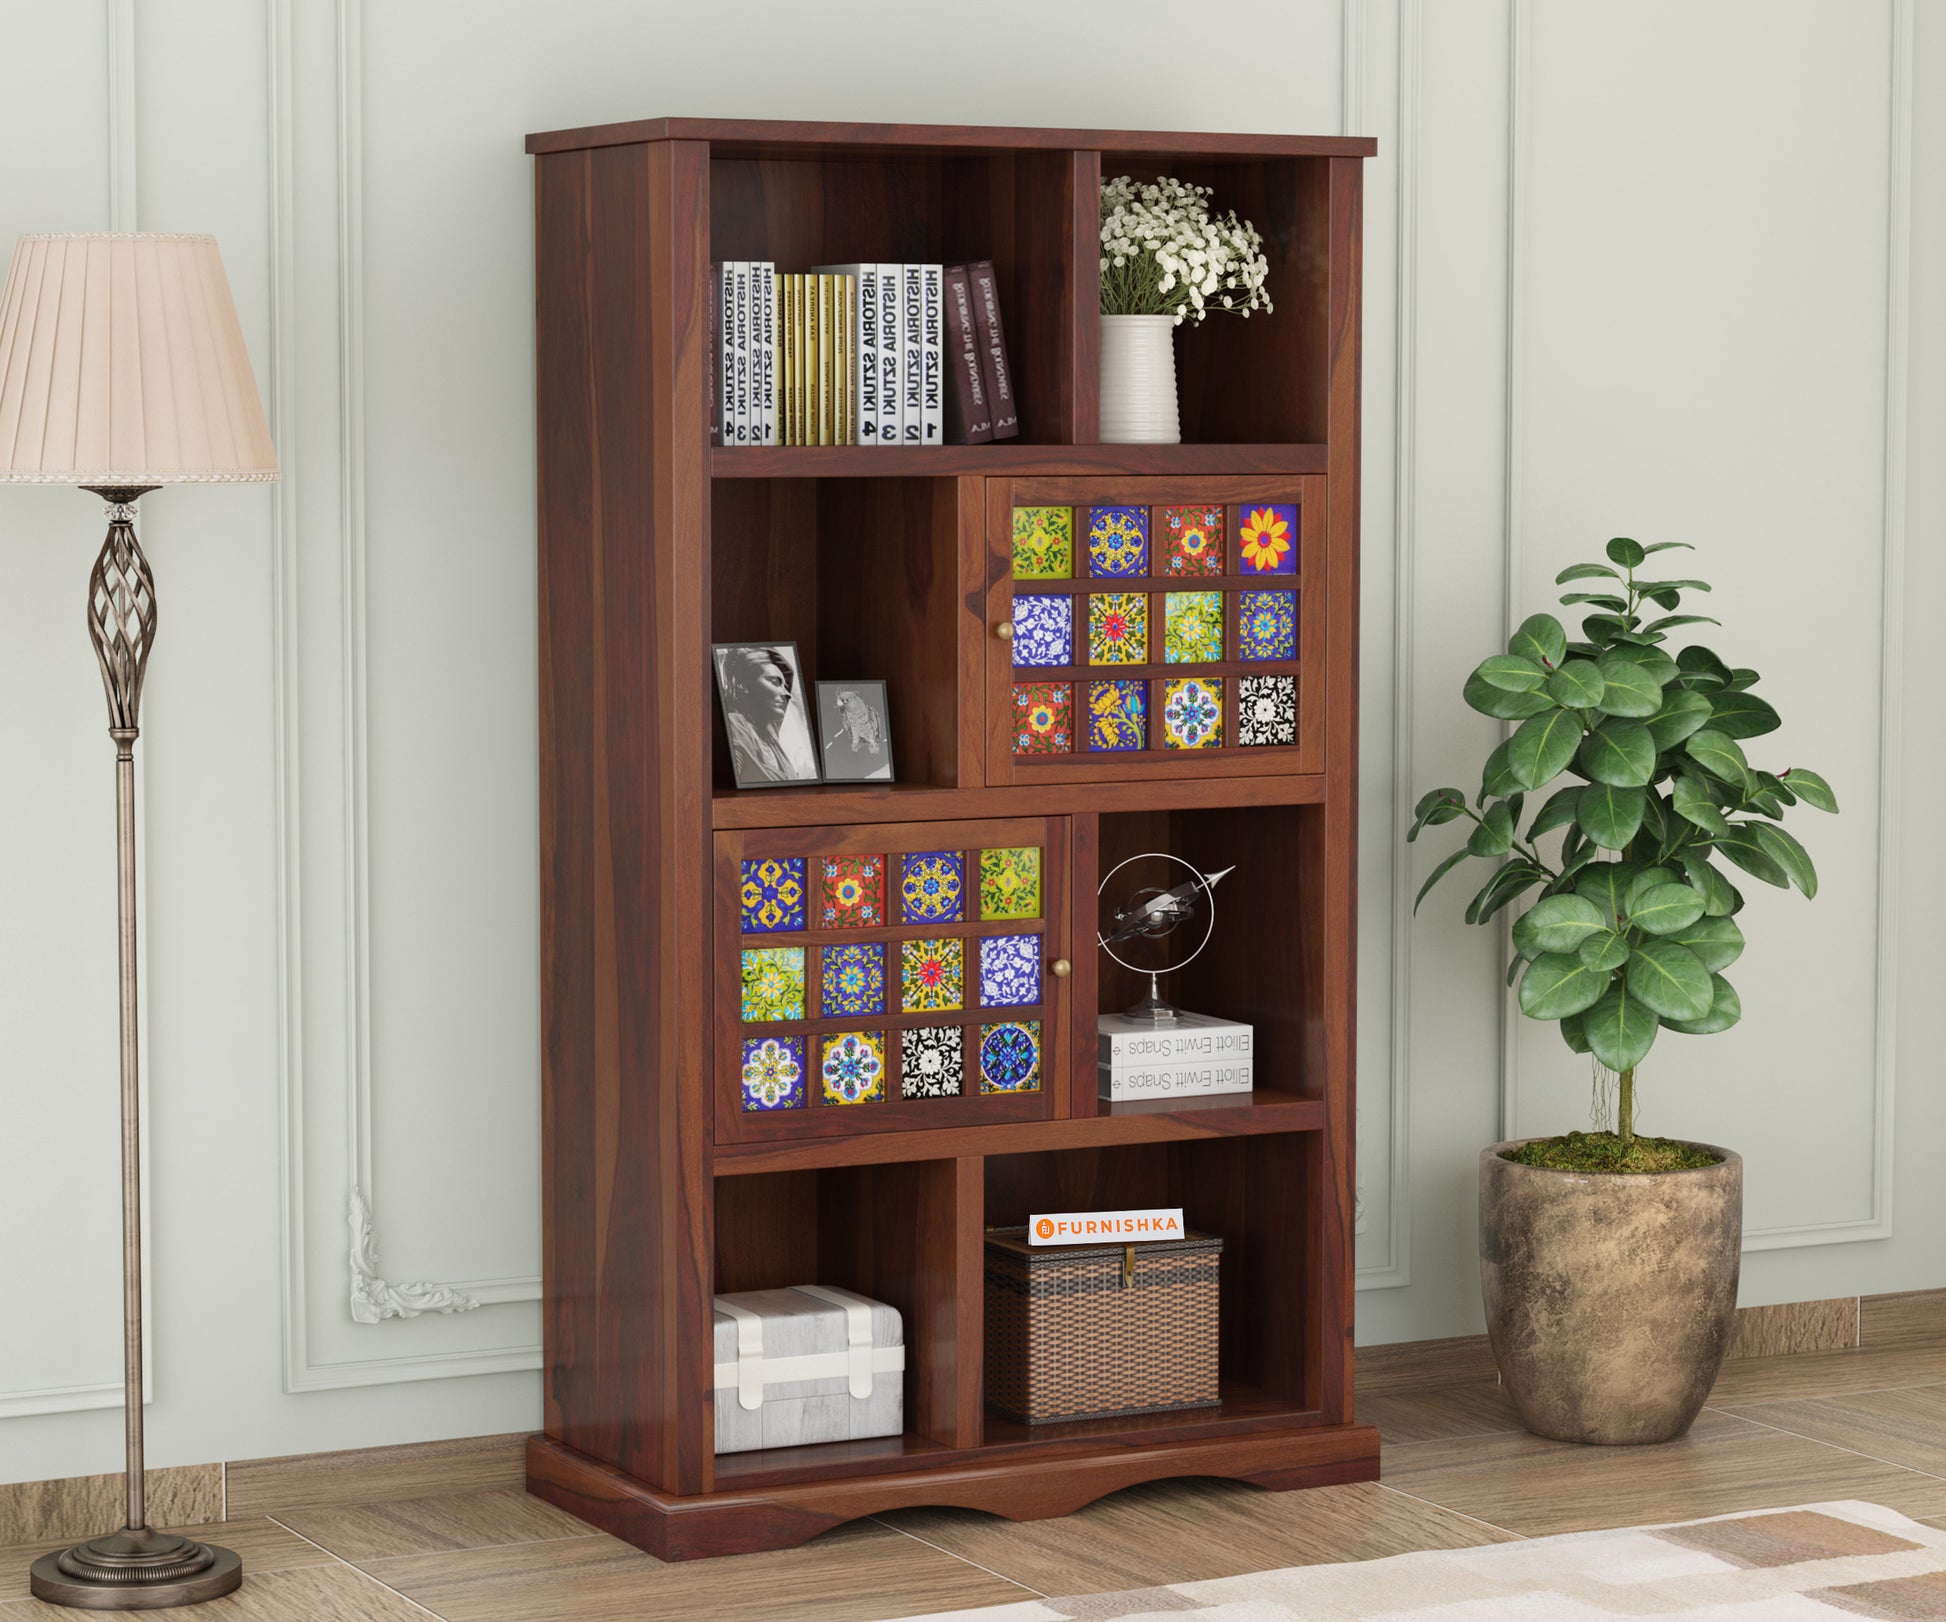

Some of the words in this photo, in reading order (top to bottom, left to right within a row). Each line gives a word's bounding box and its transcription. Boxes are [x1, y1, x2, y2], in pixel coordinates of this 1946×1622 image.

[1128, 1038, 1172, 1056] Snaps
[1176, 1037, 1212, 1055] Erwitt
[1216, 1034, 1250, 1052] Elliott
[1128, 1072, 1172, 1090] Snaps
[1176, 1070, 1212, 1088] Erwitt
[1216, 1068, 1250, 1085] Elliott
[1057, 1217, 1179, 1235] FURNISHKA
